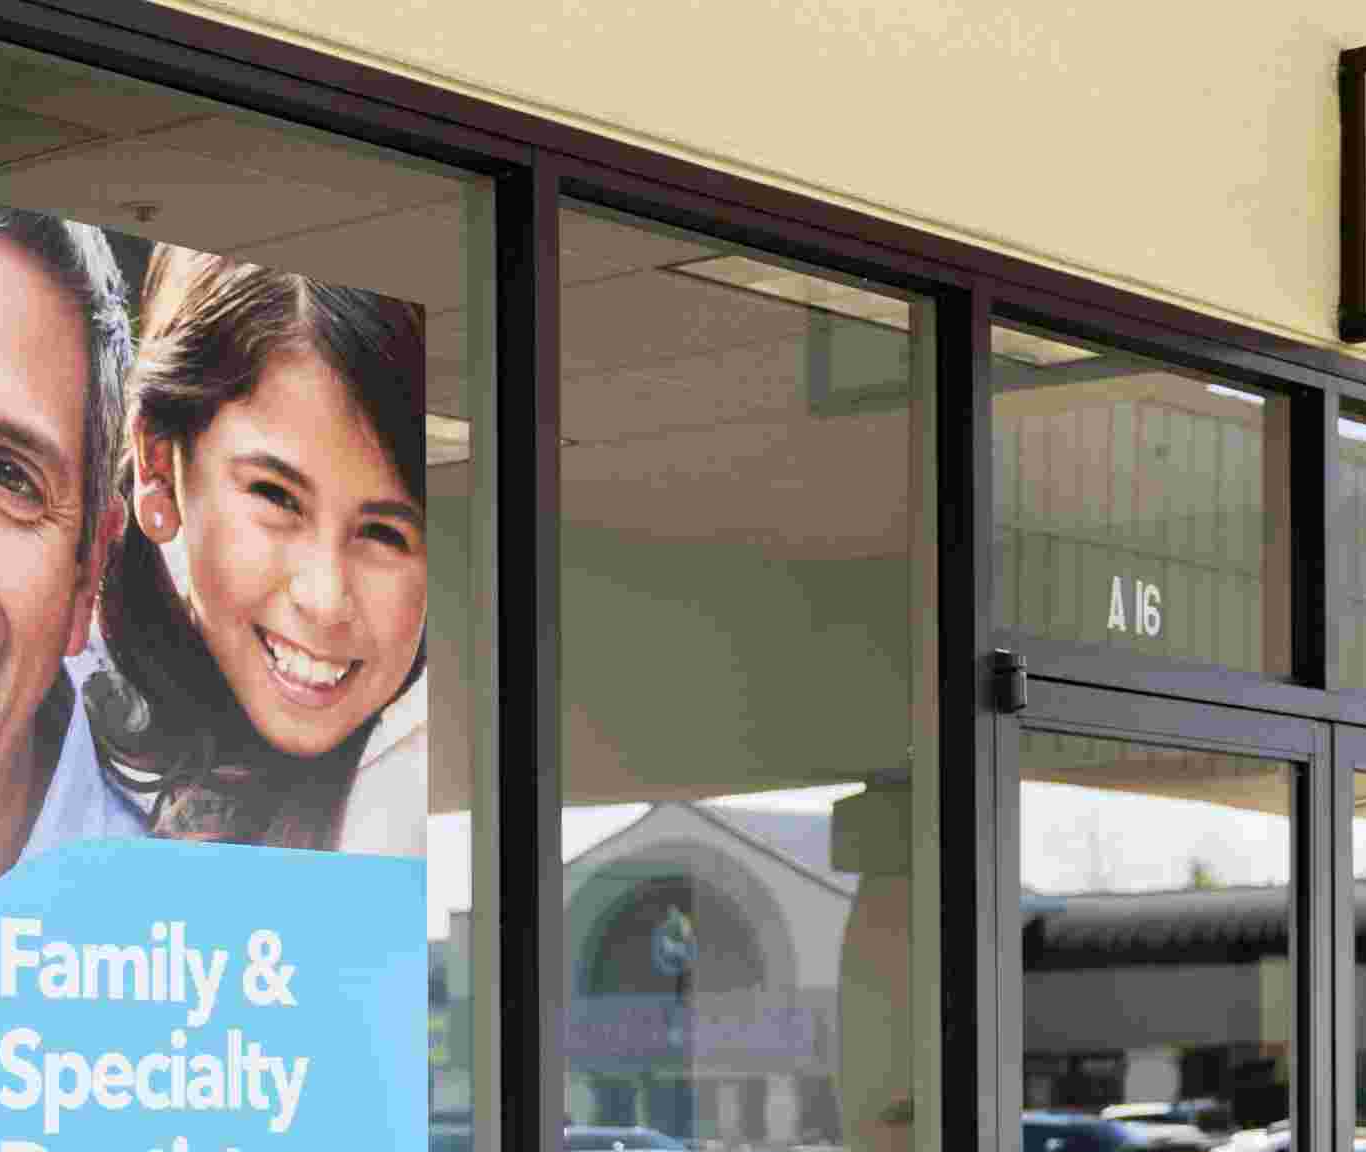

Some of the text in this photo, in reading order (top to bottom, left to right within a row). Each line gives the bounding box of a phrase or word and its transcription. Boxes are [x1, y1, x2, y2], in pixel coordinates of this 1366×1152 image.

[1107, 575, 1162, 636] A 16
[241, 929, 299, 1007] &
